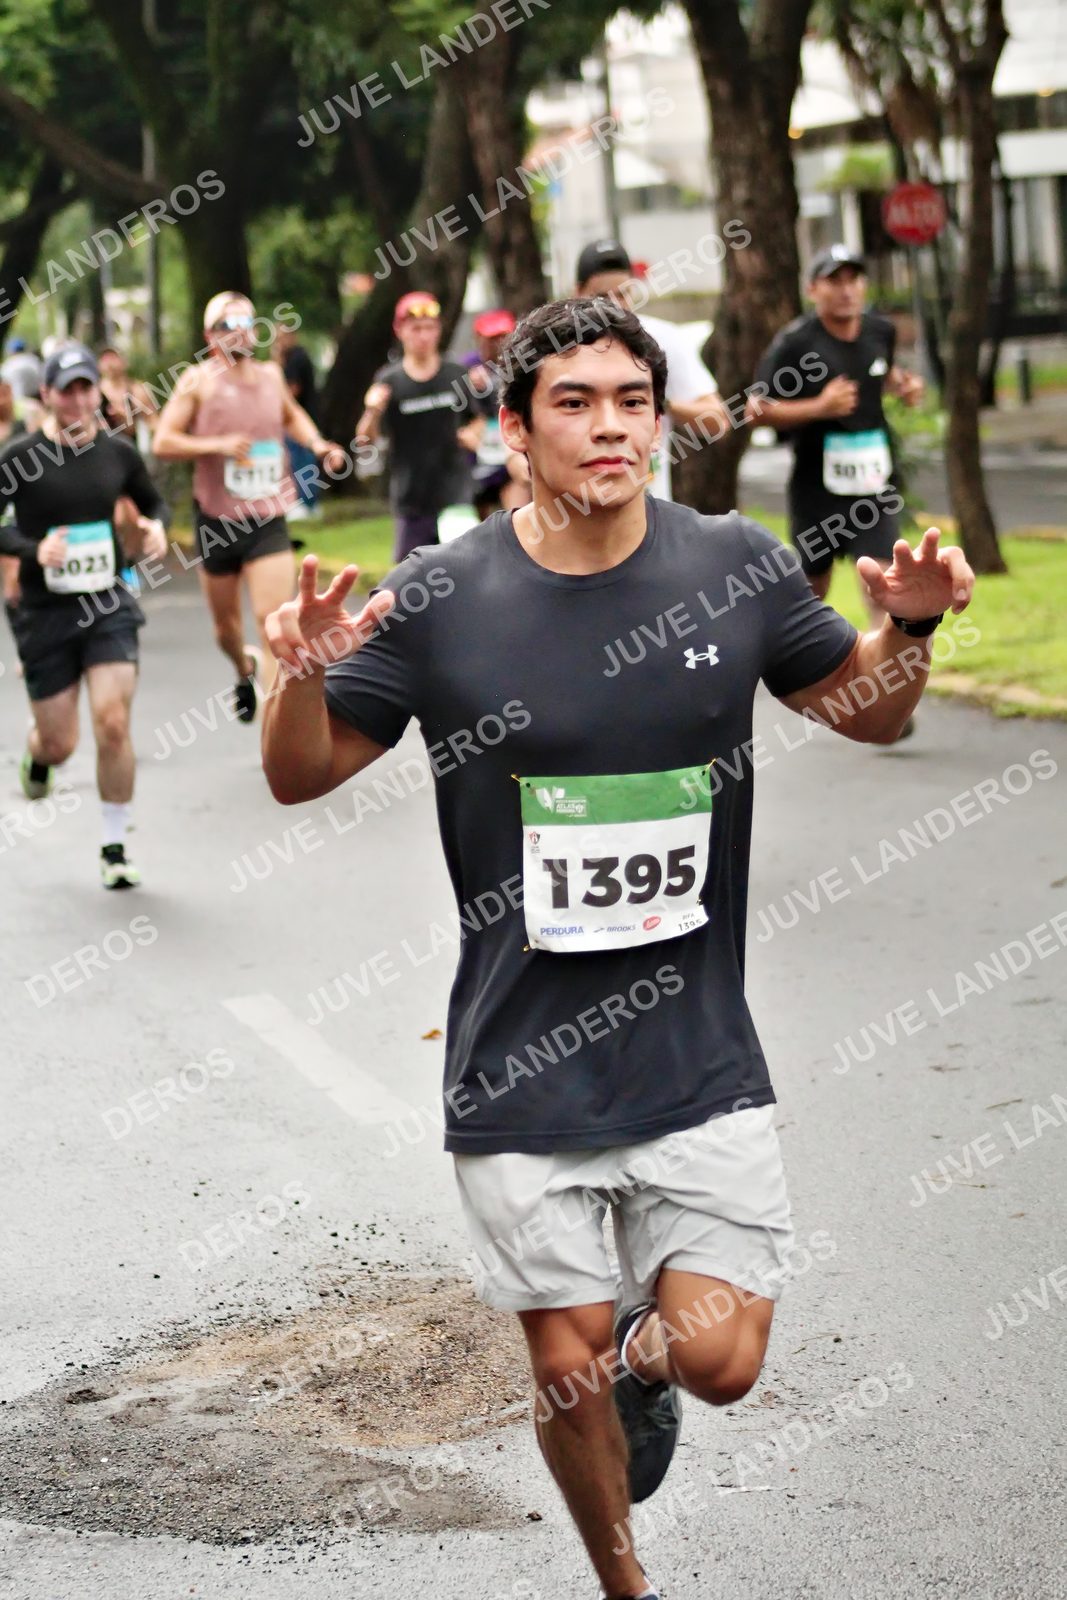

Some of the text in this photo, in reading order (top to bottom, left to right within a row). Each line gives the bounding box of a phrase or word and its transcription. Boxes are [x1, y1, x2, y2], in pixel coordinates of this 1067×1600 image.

[542, 845, 696, 909] 1395
[540, 926, 584, 936] PERDURA
[607, 925, 636, 933] BROOKS
